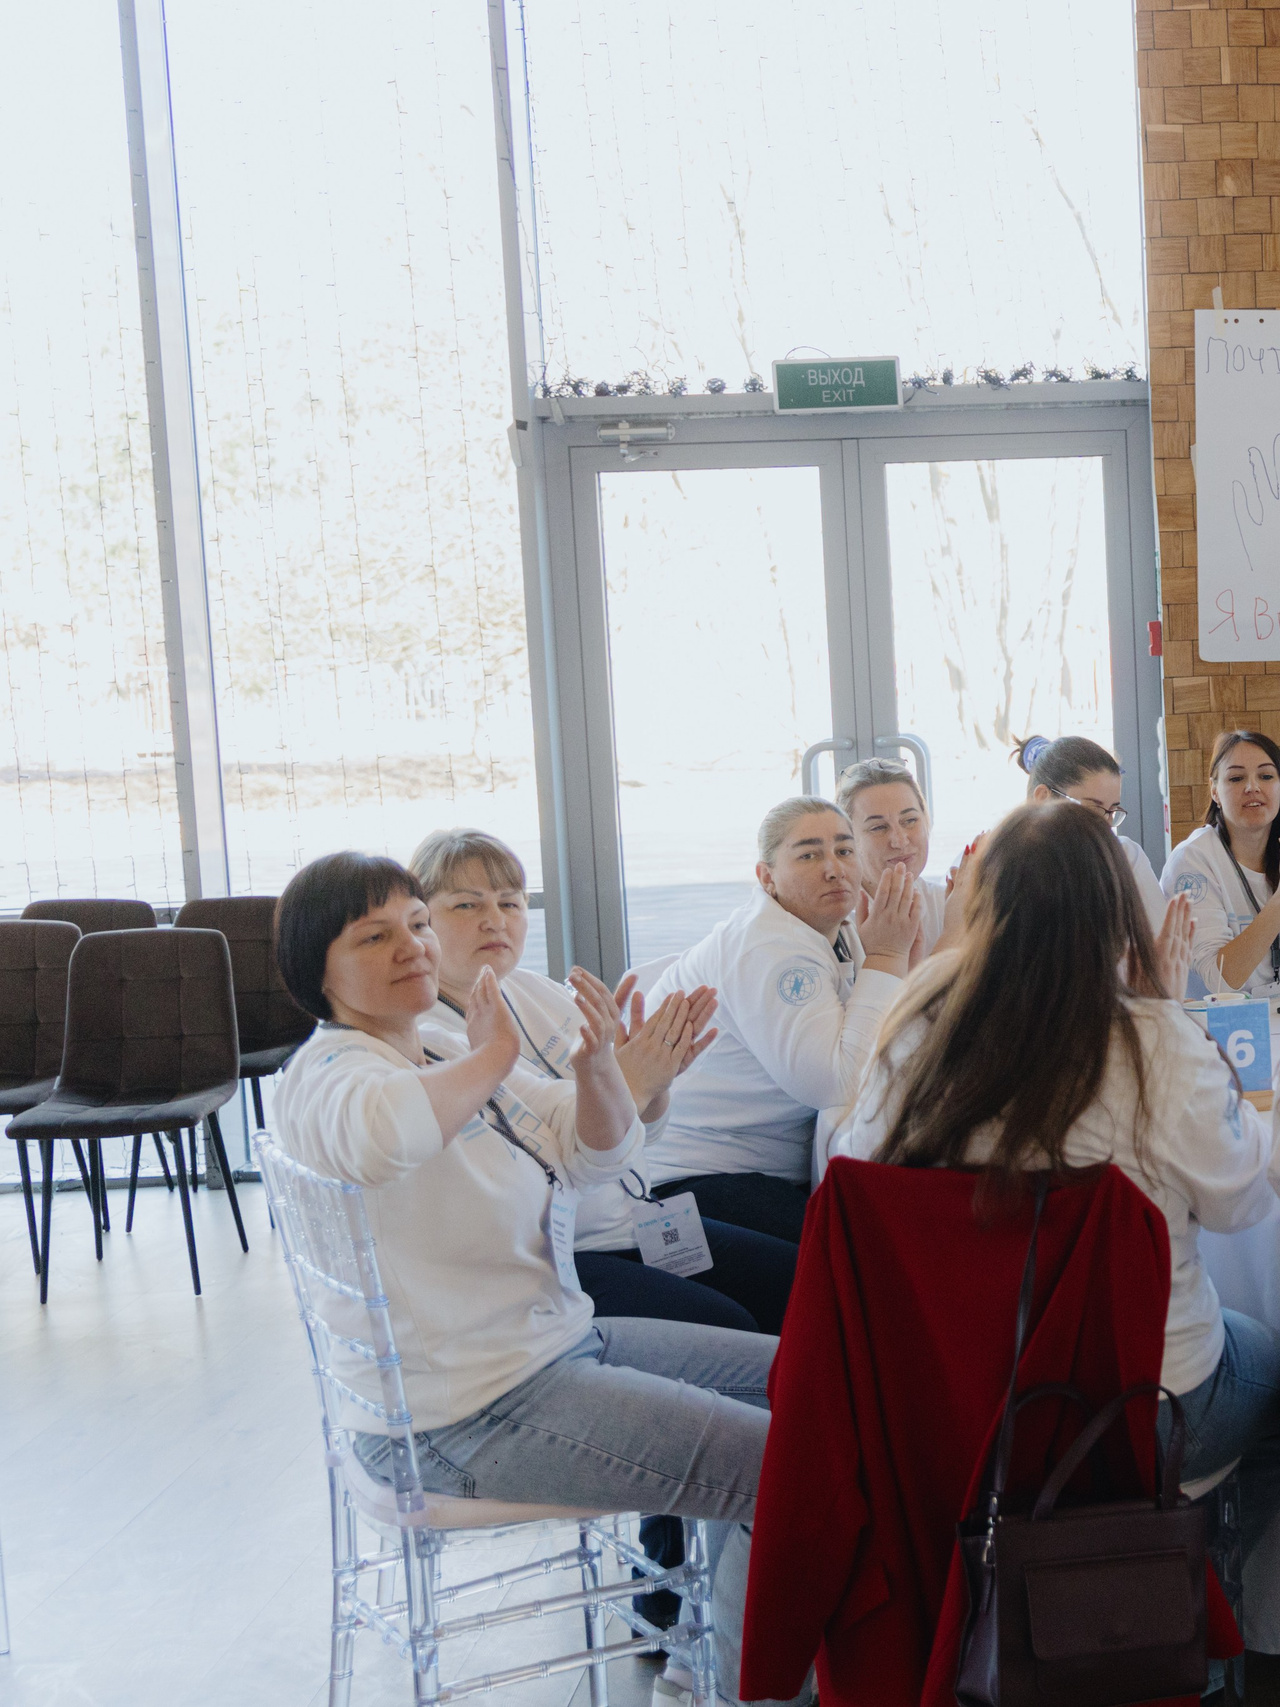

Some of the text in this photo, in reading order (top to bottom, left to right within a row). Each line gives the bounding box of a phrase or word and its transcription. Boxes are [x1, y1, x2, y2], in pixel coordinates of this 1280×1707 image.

[807, 367, 866, 388] ВЫХОД
[821, 389, 856, 403] EXIT
[1208, 588, 1240, 642] Я
[1226, 1029, 1256, 1069] 6
